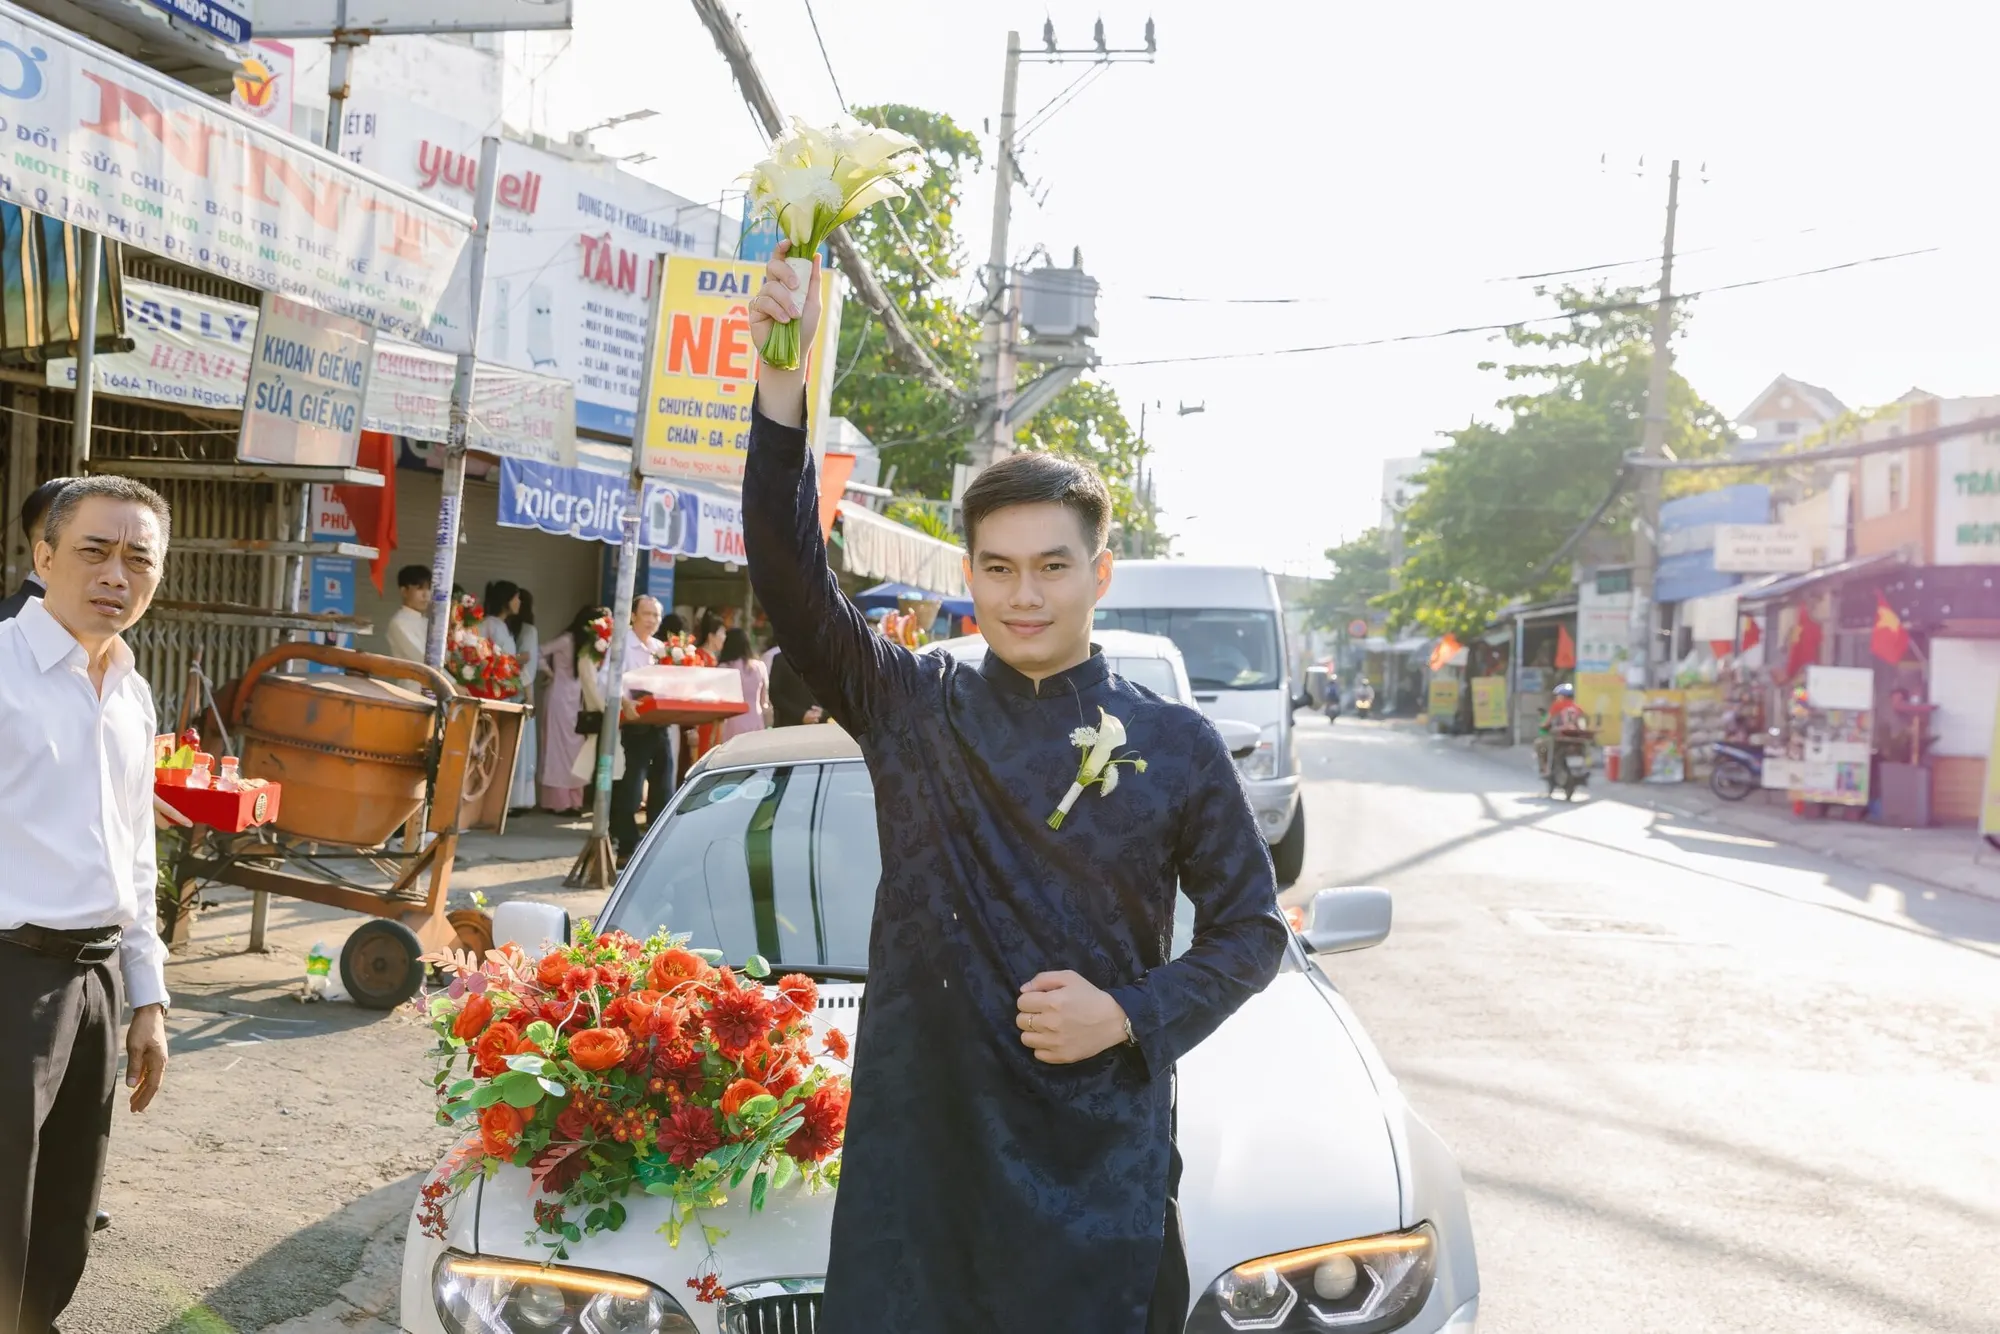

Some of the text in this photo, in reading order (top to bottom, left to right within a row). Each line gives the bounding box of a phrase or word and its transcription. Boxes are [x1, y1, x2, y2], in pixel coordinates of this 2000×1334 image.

[14, 152, 100, 197] MOTEUR
[579, 231, 638, 294] TÂN
[698, 270, 750, 298] ĐẠI
[200, 313, 248, 343] LÝ
[262, 334, 315, 375] KHOAN
[318, 346, 362, 388] GIẾNG
[666, 305, 760, 393] NỆ
[103, 372, 141, 390] 164A
[254, 374, 355, 433] SỬA GIẾNG
[658, 397, 703, 419] CHUYÊN
[705, 401, 736, 421] CUNG
[709, 435, 724, 448] GA
